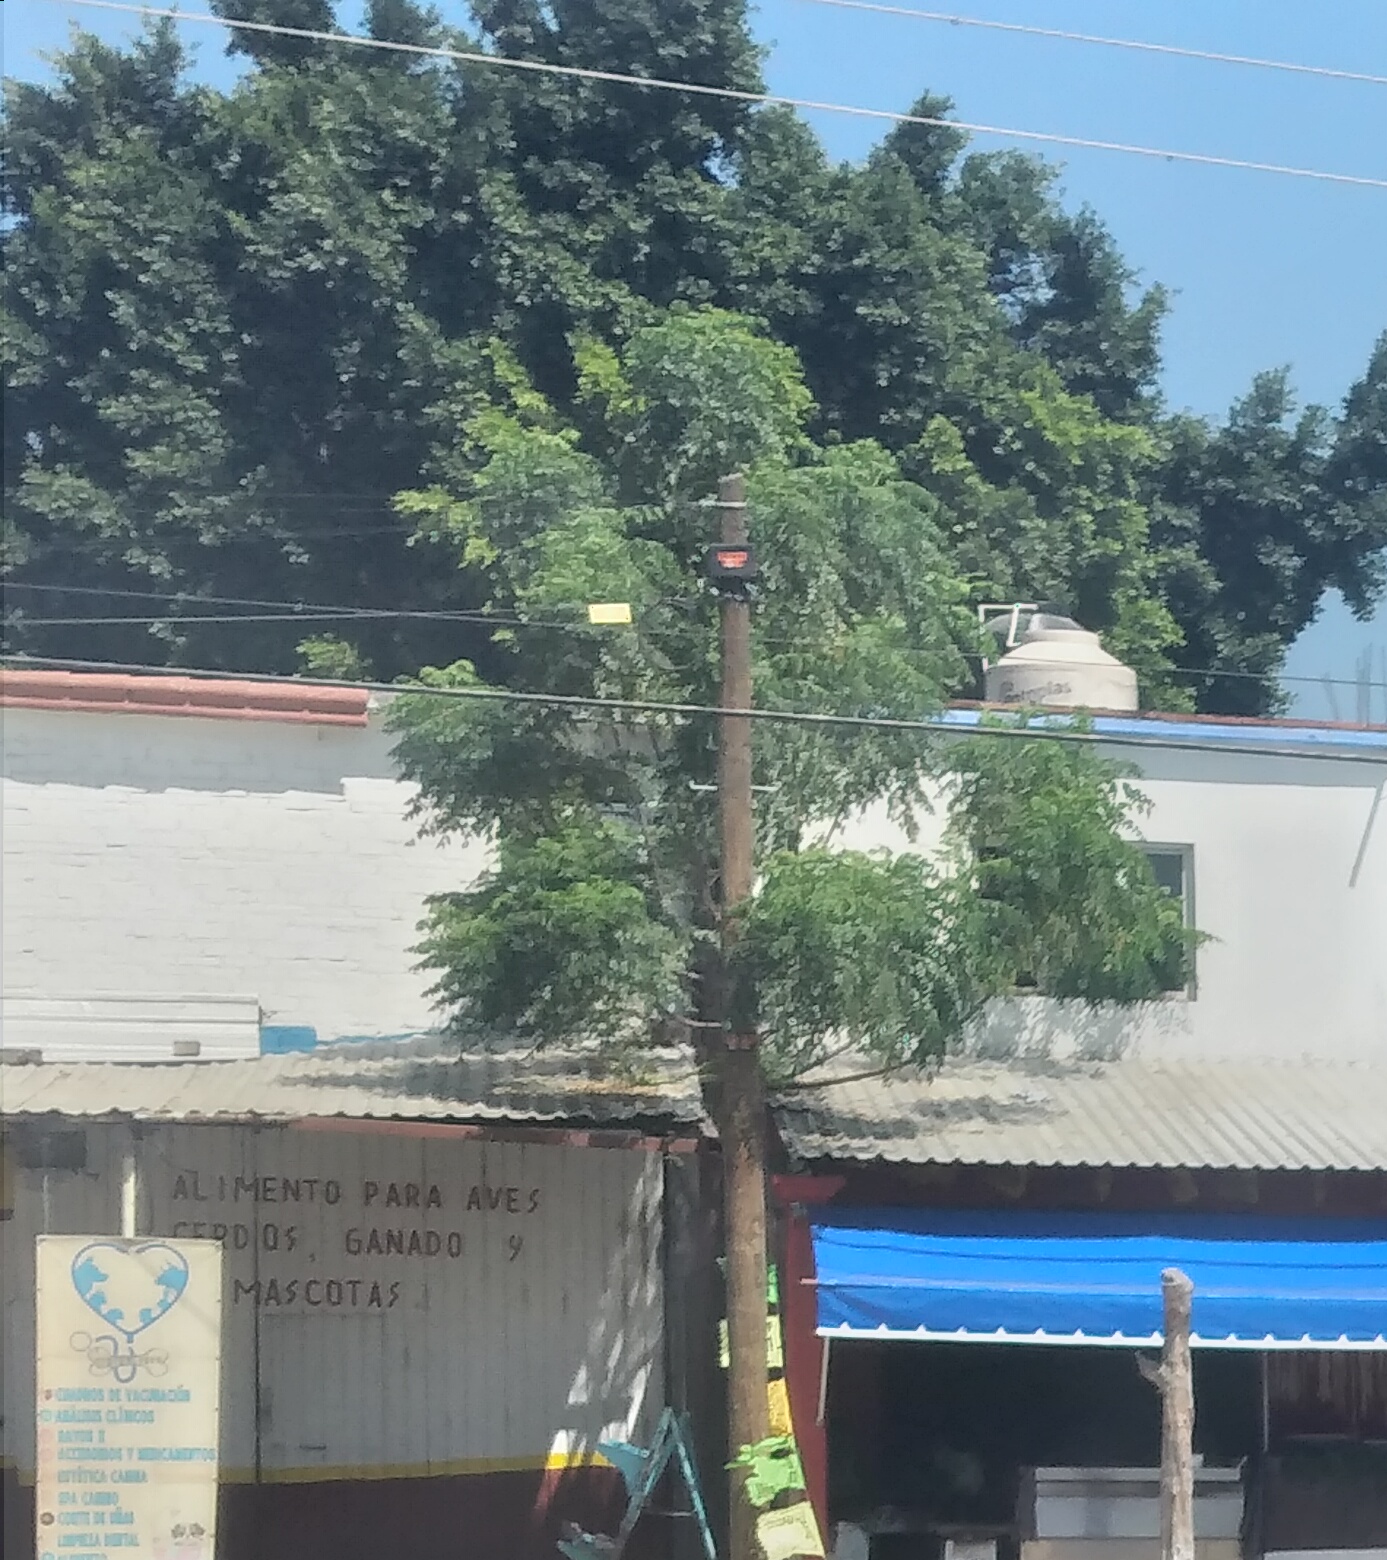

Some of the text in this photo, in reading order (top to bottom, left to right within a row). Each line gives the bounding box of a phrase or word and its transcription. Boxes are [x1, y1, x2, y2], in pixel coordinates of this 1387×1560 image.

[173, 1172, 540, 1213] ALIMENTO PARA AVES
[345, 1228, 461, 1258] GANADO
[233, 1279, 400, 1308] MASCOTAS
